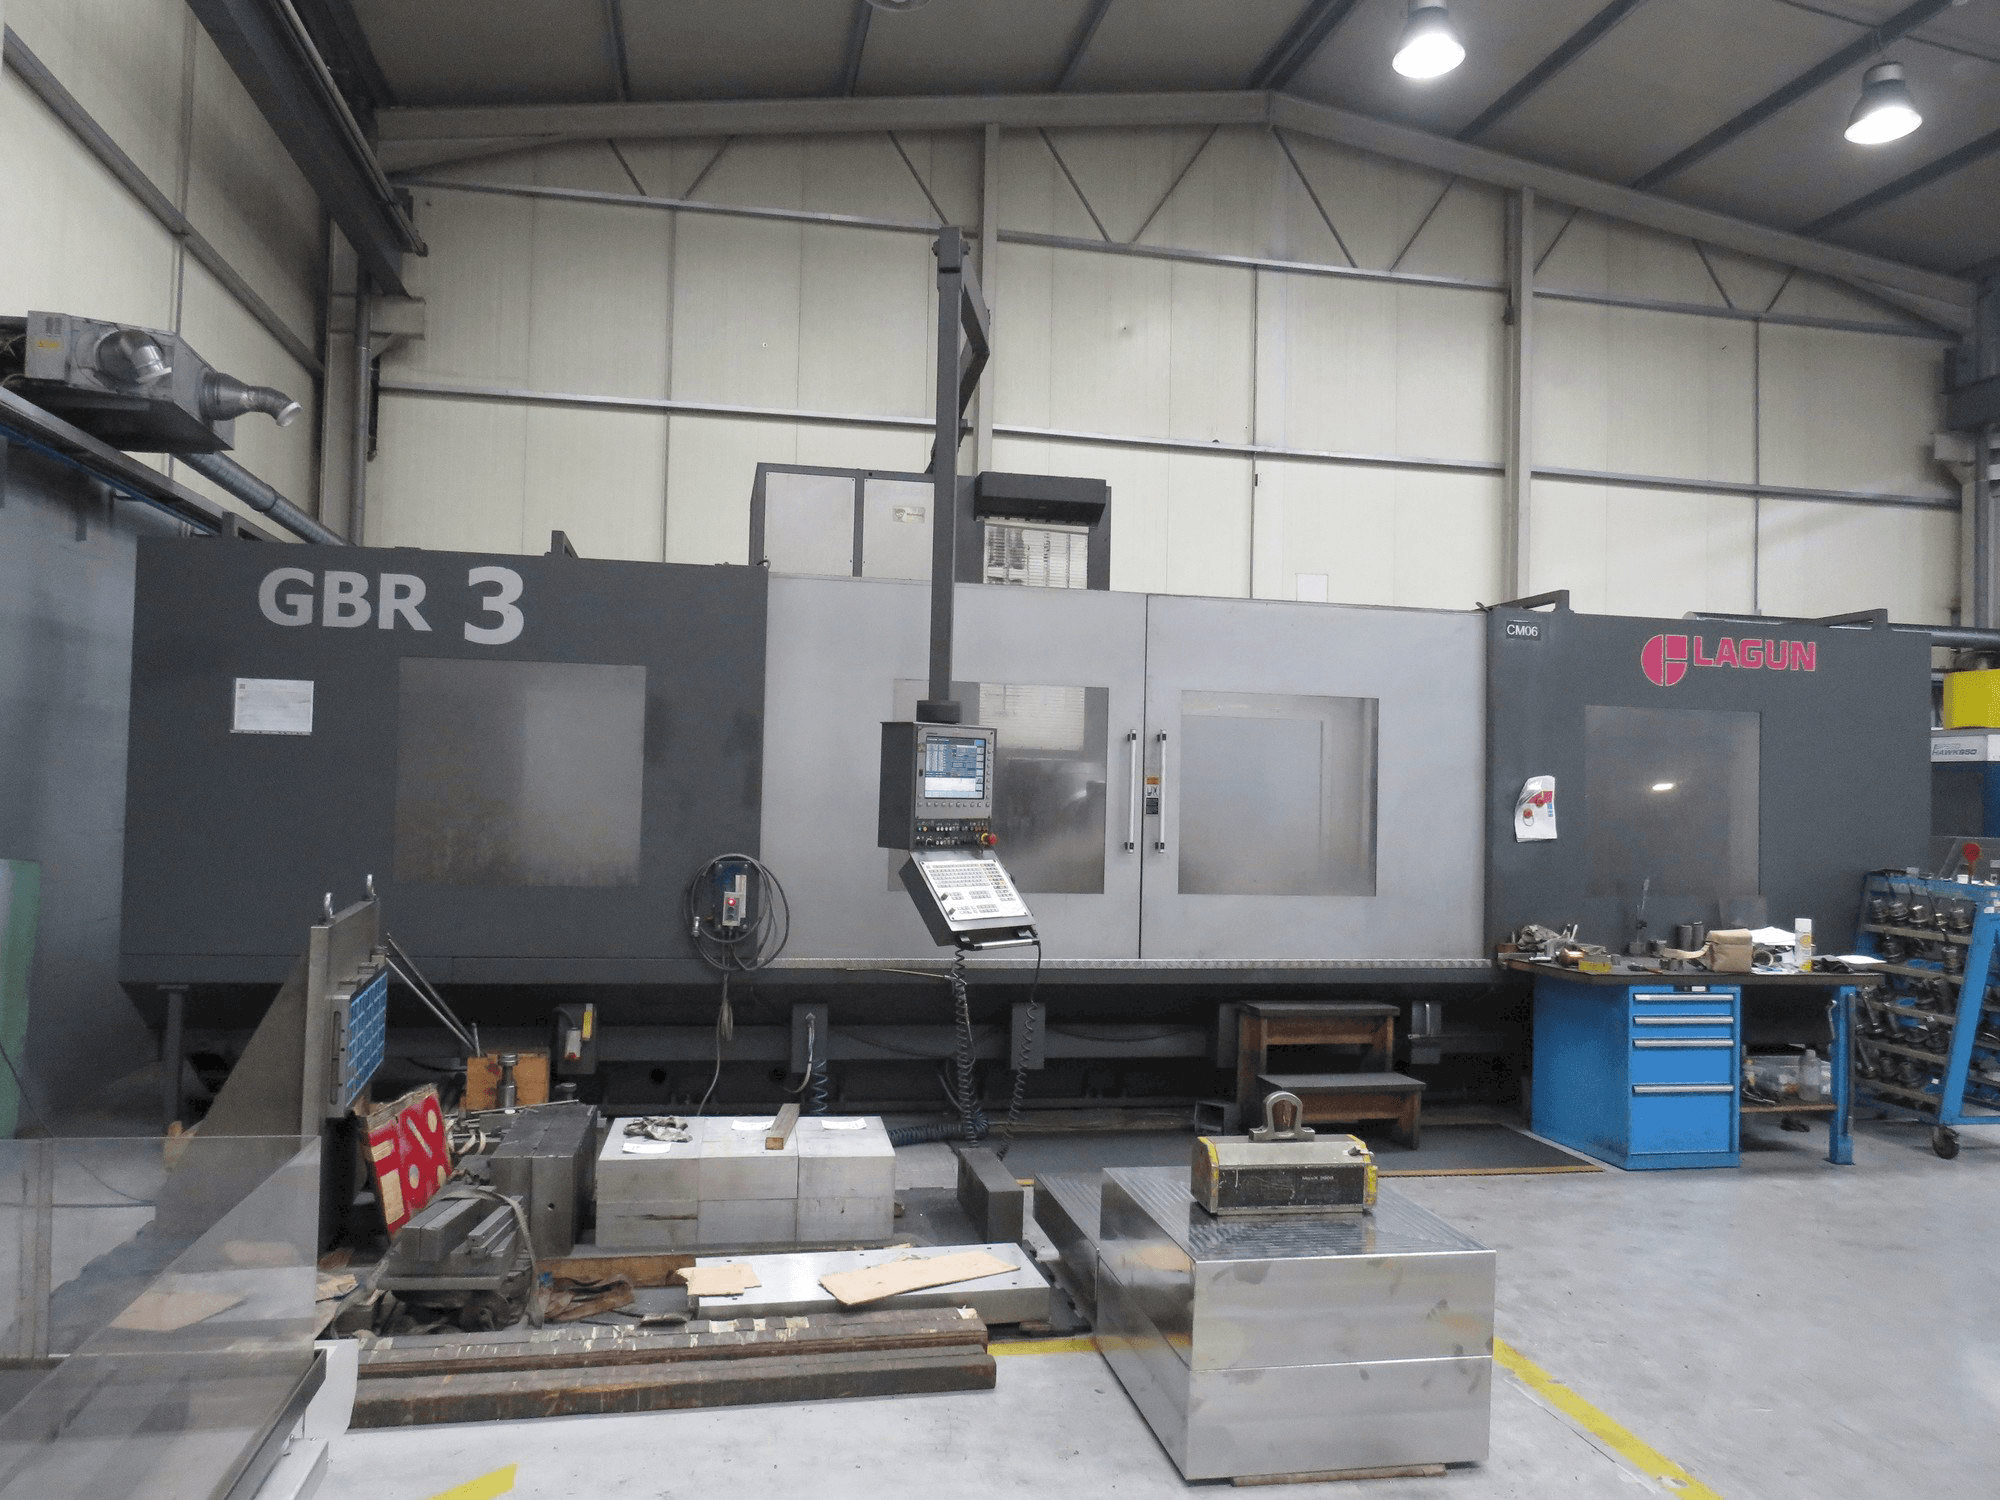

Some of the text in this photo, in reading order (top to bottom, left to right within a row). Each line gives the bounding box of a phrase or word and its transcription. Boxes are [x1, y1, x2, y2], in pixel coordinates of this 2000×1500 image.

[258, 566, 525, 645] GBR 3
[1506, 624, 1539, 638] CM06
[1693, 635, 1816, 671] LAGUN
